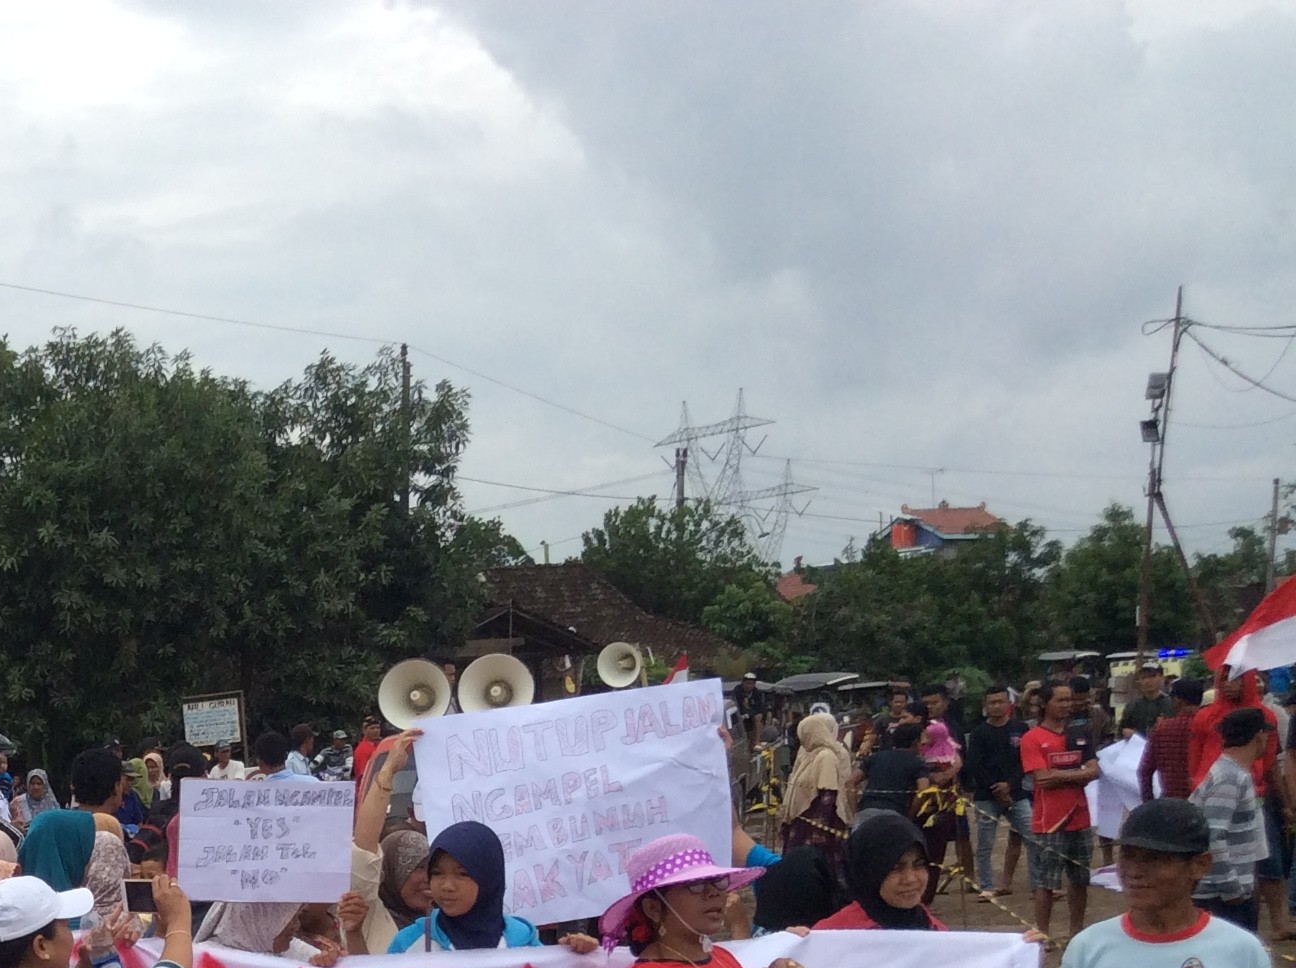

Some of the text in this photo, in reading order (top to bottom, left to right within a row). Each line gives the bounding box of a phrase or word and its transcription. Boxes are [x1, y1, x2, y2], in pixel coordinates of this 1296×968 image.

[445, 692, 717, 781] NUTUP JALAN
[452, 765, 623, 824] NGAMPEL
[498, 796, 670, 864] EMBUNUH
[504, 838, 642, 914] AKYAT
